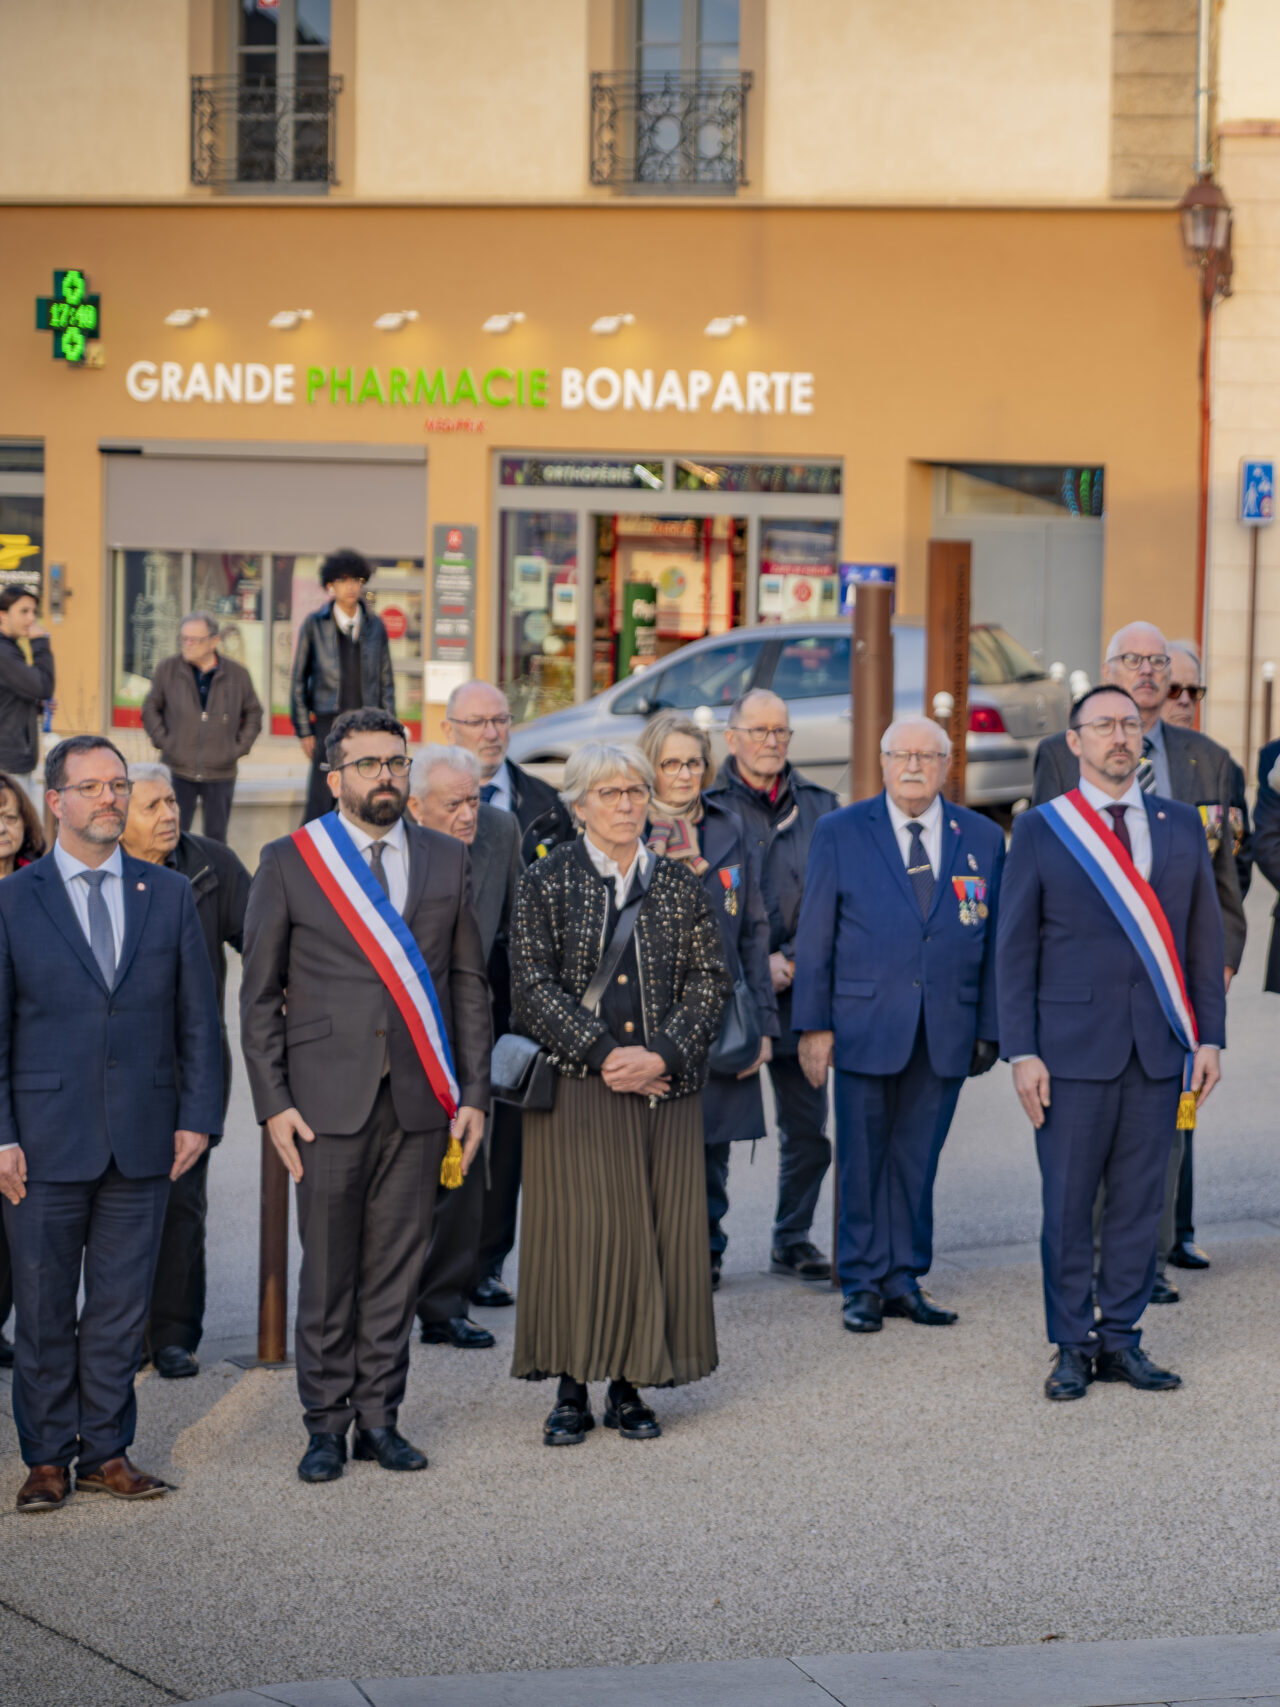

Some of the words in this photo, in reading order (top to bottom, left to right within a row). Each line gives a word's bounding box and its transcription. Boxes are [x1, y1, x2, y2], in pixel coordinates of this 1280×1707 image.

[126, 361, 295, 404] GRANDE
[307, 366, 548, 407] PHARMACIE
[561, 367, 815, 414] BONAPARTE
